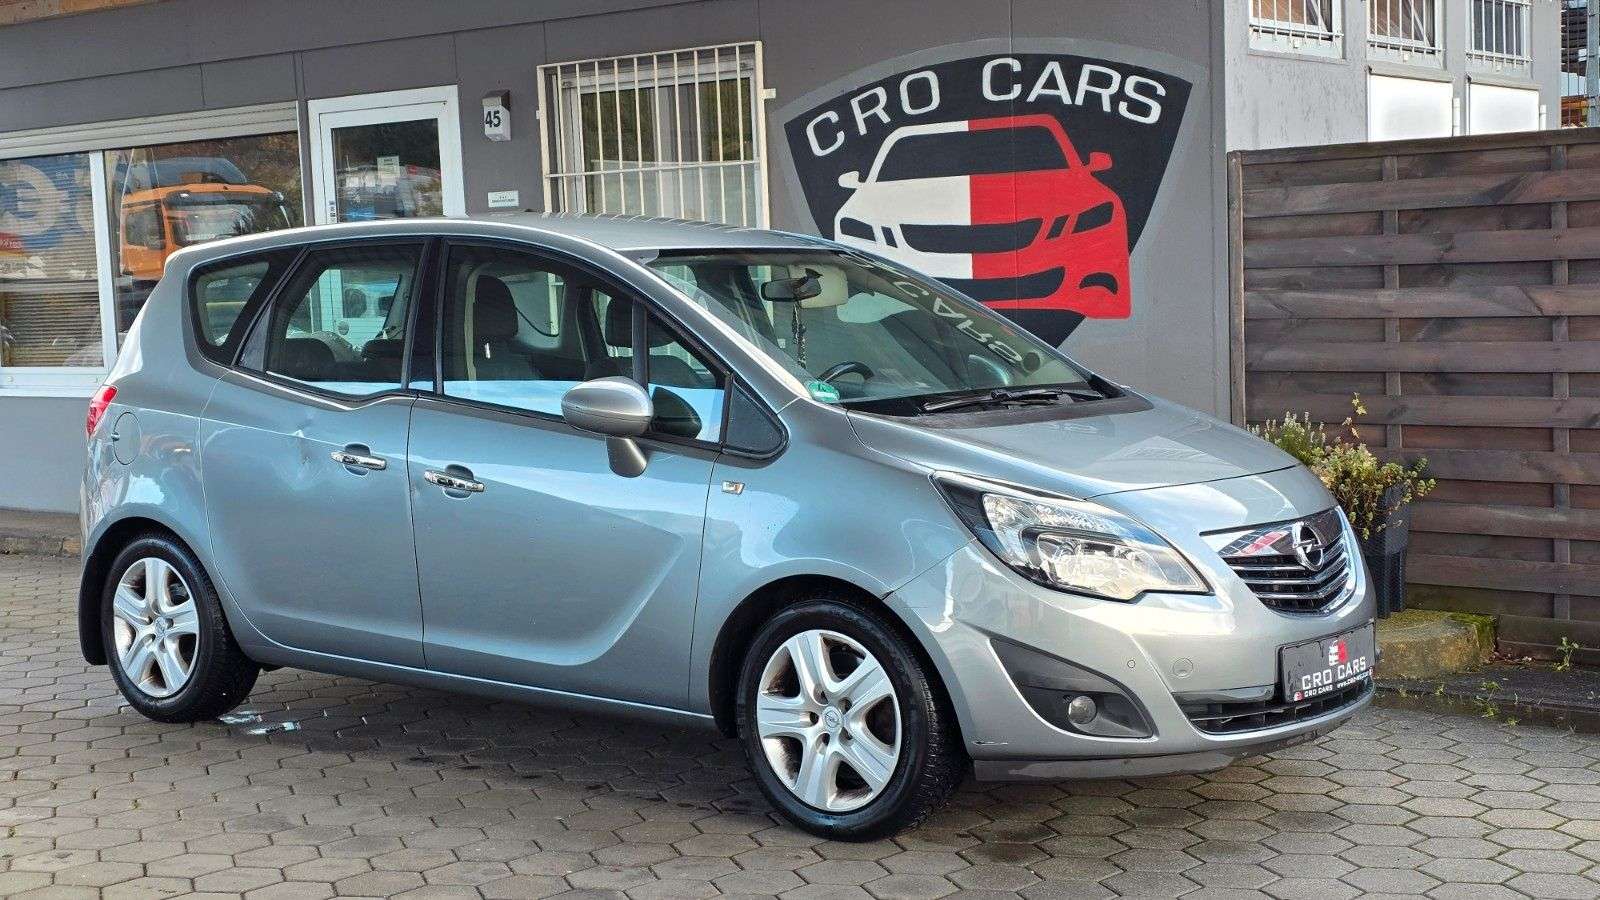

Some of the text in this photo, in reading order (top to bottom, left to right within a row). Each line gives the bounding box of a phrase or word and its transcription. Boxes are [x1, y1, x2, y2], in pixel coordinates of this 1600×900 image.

[485, 110, 501, 128] 45
[805, 57, 1166, 157] CRO CARS
[1302, 669, 1332, 690] CRO
[1337, 656, 1366, 680] CARS
[1304, 689, 1317, 698] CRO
